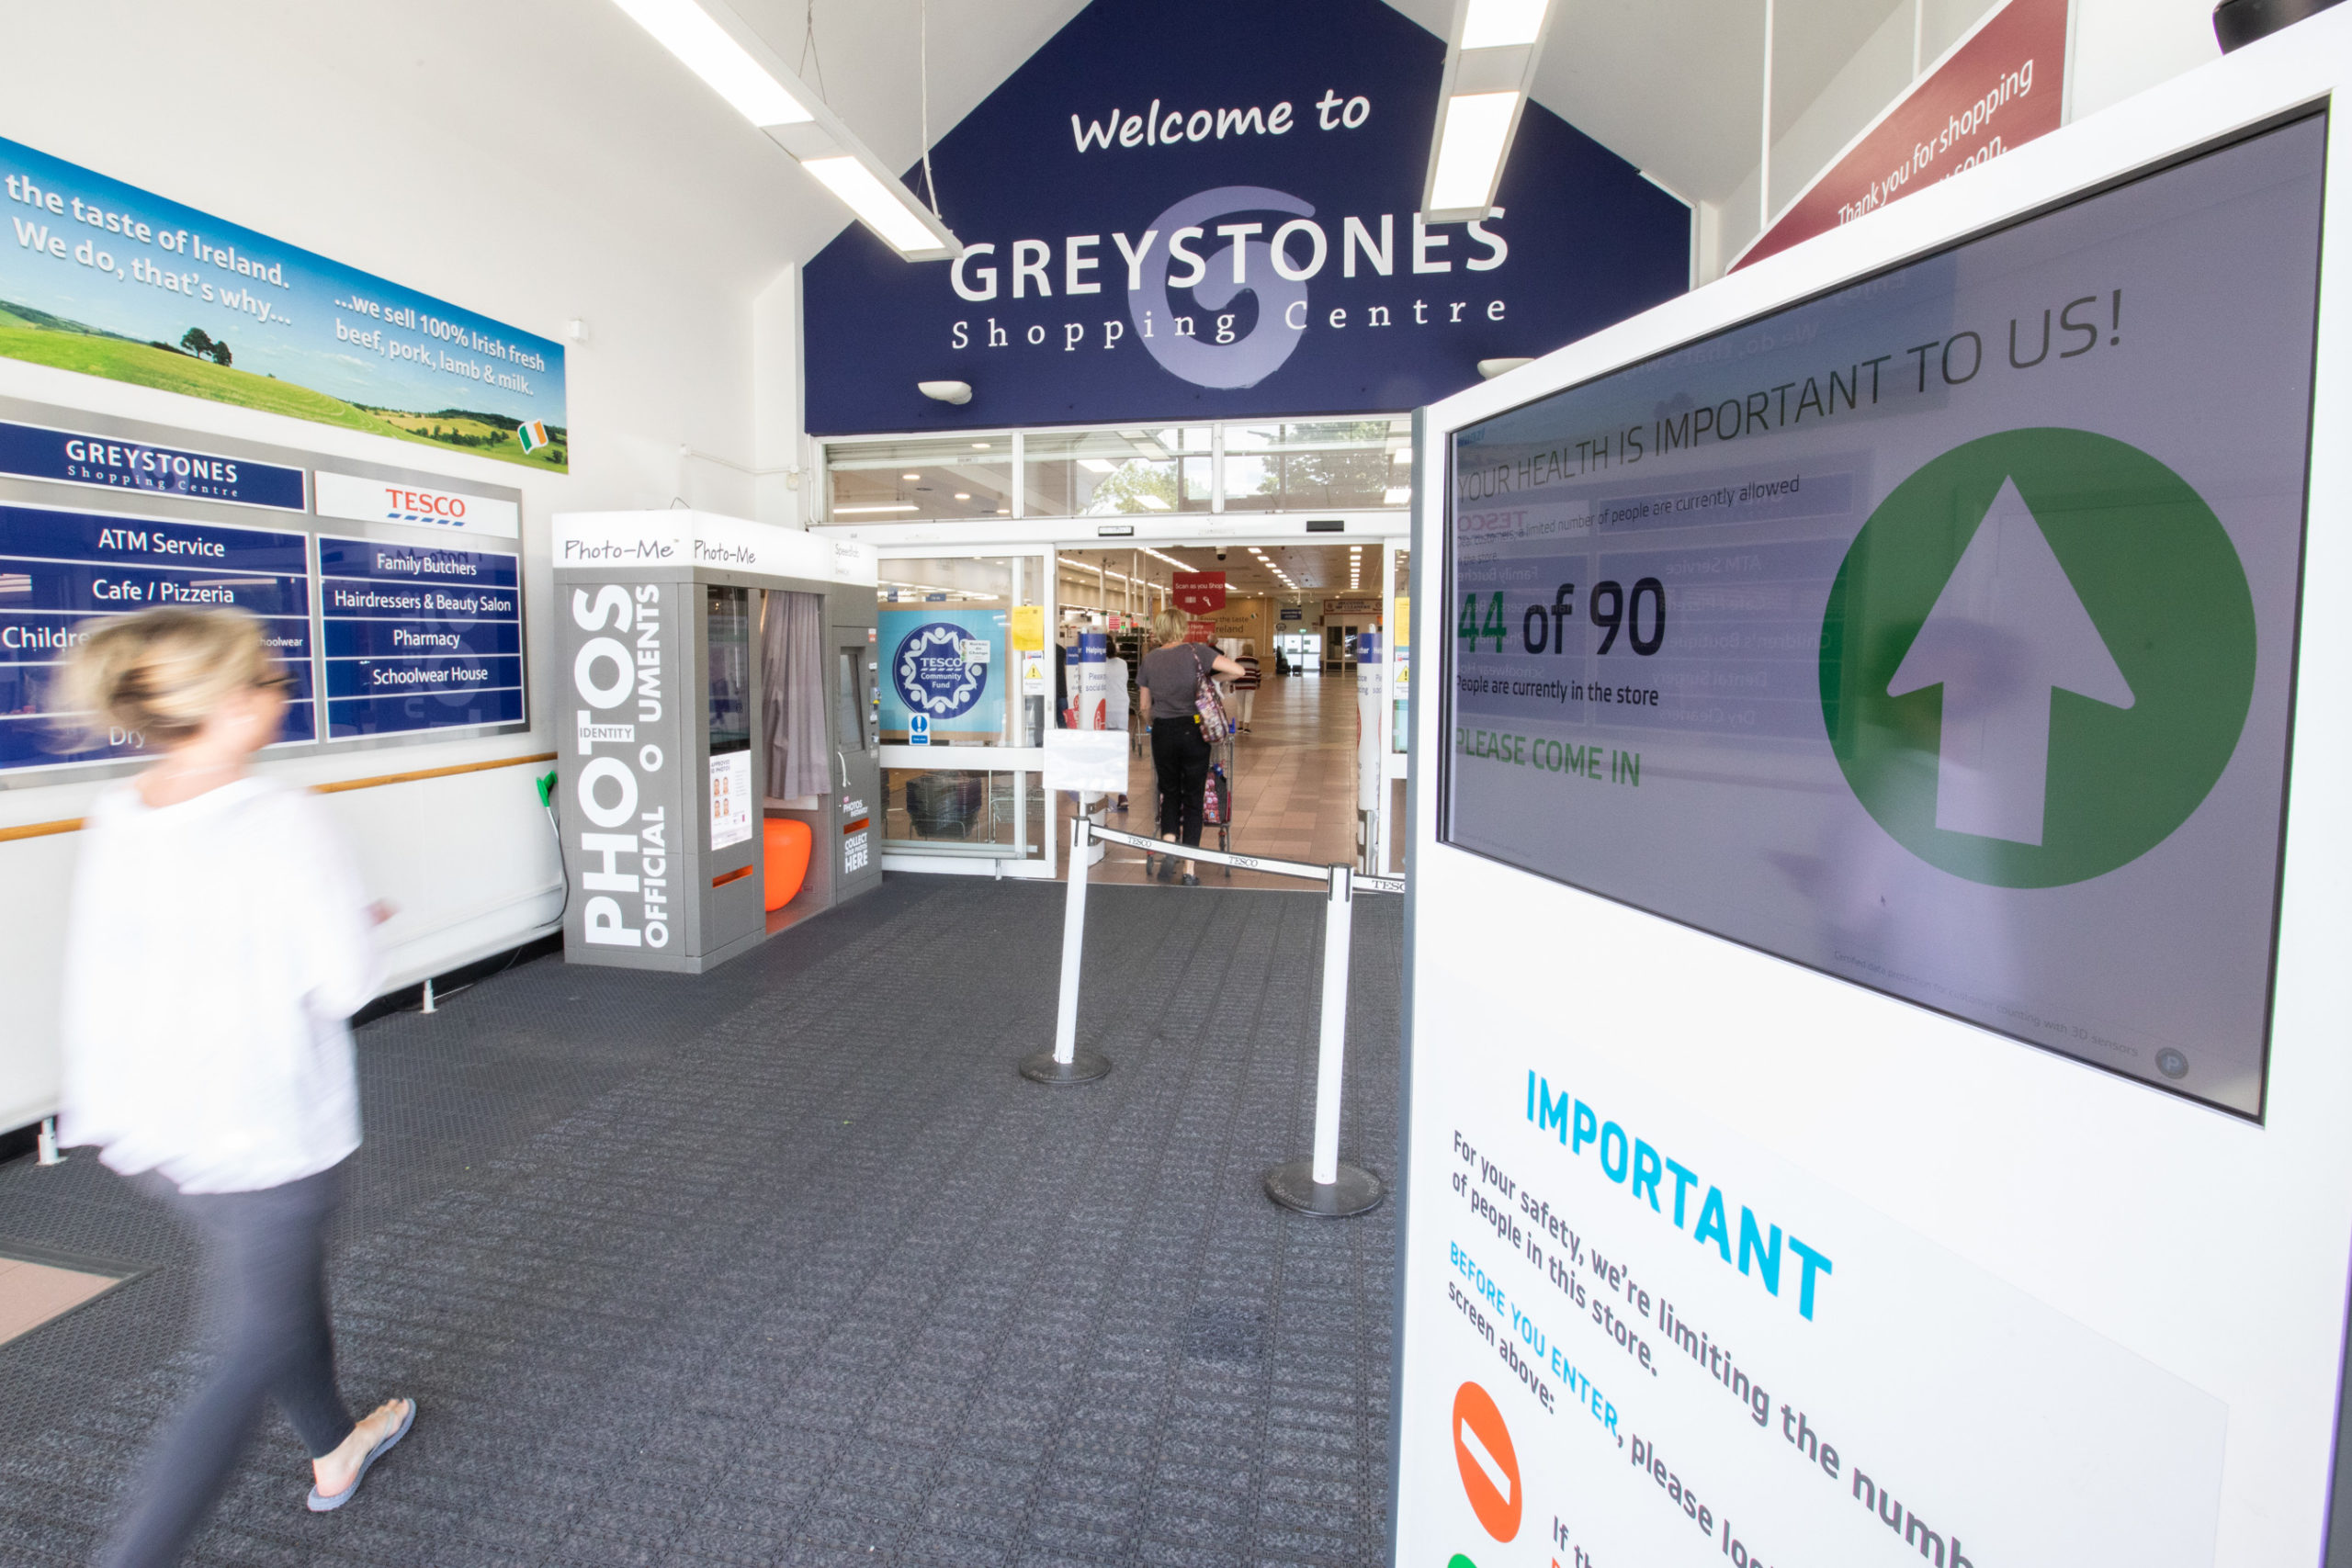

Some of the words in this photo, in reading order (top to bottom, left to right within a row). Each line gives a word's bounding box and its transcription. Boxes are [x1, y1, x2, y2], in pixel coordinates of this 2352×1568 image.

[1071, 98, 1294, 152] Welcome
[1317, 89, 1370, 130] to
[1838, 182, 1879, 226] Thank
[1881, 162, 1909, 207] you
[1913, 139, 1937, 175] for
[1939, 59, 2033, 152] shopping
[6, 173, 63, 215] the
[71, 195, 152, 244] taste
[159, 228, 189, 257] of
[194, 234, 290, 289] Ireland.
[12, 217, 66, 259] We
[75, 236, 125, 282] do,
[131, 256, 214, 301] that’s
[220, 286, 292, 326] why...
[951, 207, 1508, 301] GREYSTONES
[334, 294, 380, 320] ...we
[383, 305, 416, 331] sell
[420, 314, 469, 348] 100%
[472, 331, 506, 359] Irish
[509, 344, 546, 373] fresh
[952, 310, 1235, 351] Shopping
[1285, 299, 1506, 330] Centre
[335, 318, 383, 353] beef,
[389, 337, 436, 373] pork,
[440, 353, 481, 380] lamb
[483, 366, 496, 384] &
[498, 367, 535, 397] milk.
[1457, 465, 1510, 503] YOUR
[1518, 434, 1608, 491] HEALTH
[1620, 425, 1643, 465] IS
[1656, 355, 1892, 457] IMPORTANT
[1906, 331, 1982, 393] TO
[2009, 288, 2121, 369] US!
[65, 439, 238, 484] GREYSTONES
[68, 465, 166, 491] Shopping
[177, 479, 239, 498] Centre
[385, 488, 466, 519] TESCO
[1526, 521, 1555, 537] limited
[1558, 515, 1594, 532] number
[1598, 510, 1610, 525] of
[1611, 502, 1649, 526] people
[1653, 500, 1672, 515] are
[1676, 488, 1735, 512] currently
[1739, 474, 1800, 502] allowed
[98, 527, 147, 551] ATM
[153, 533, 225, 558] Service
[564, 540, 674, 559] Photo-Me
[694, 539, 756, 565] Photo-Me
[377, 553, 421, 576] Family
[424, 555, 477, 577] Butchers
[93, 579, 141, 602] Cafe
[147, 581, 154, 601] /
[161, 582, 234, 604] Pizzeria
[334, 591, 421, 610] Hairdressers
[424, 594, 435, 609] &
[436, 594, 478, 614] Beauty
[480, 596, 511, 612] Salon
[1216, 625, 1243, 633] reland
[1457, 591, 1507, 653] 44
[1523, 583, 1575, 654] of
[1590, 577, 1666, 656] 90
[2, 626, 90, 649] Childre
[257, 636, 303, 647] hoolwear
[394, 628, 460, 649] Pharmacy
[373, 668, 449, 685] Schoolwear
[451, 666, 488, 682] House
[920, 658, 963, 667] TESCO
[921, 672, 962, 682] Community
[1457, 675, 1488, 695] People
[1492, 681, 1509, 694] are
[1512, 680, 1567, 704] currently
[1572, 680, 1583, 700] in
[1589, 682, 1611, 702] the
[1617, 686, 1658, 705] store
[109, 726, 146, 749] Dry
[579, 728, 633, 739] IDENTITY
[572, 584, 641, 947] PHOTOS
[1456, 728, 1526, 765] PLEASE
[1532, 739, 1603, 780] COME
[1611, 750, 1640, 787] IN
[1127, 837, 1152, 848] TESCO
[643, 807, 669, 948] OFFICIAL
[845, 850, 868, 874] HERE
[1228, 856, 1259, 868] TESCO
[1372, 880, 1405, 891] TESC
[1996, 1004, 2041, 1027] counting
[2042, 1019, 2067, 1034] with
[2072, 1025, 2088, 1041] 3D
[2091, 1035, 2138, 1056] sensors
[1526, 1069, 1833, 1322] IMPORTANT
[1453, 1172, 1467, 1197] of
[1471, 1188, 1521, 1249] people
[1527, 1232, 1543, 1269] in
[1549, 1255, 1586, 1309] this
[1592, 1299, 1657, 1377] store.
[1454, 1130, 1476, 1167] For
[1481, 1156, 1516, 1200] your
[1521, 1191, 1584, 1266] safety,
[1591, 1248, 1650, 1317] we’re
[1658, 1297, 1770, 1427] limiting
[1781, 1404, 1840, 1480] the
[1449, 1280, 1495, 1347] screen
[1499, 1338, 1555, 1415] above:
[1450, 1240, 1506, 1317] BEFORE
[1510, 1302, 1545, 1358] YOU
[1552, 1346, 1623, 1449] ENTER,
[1632, 1434, 1713, 1537] please
[1553, 1515, 1569, 1551] If
